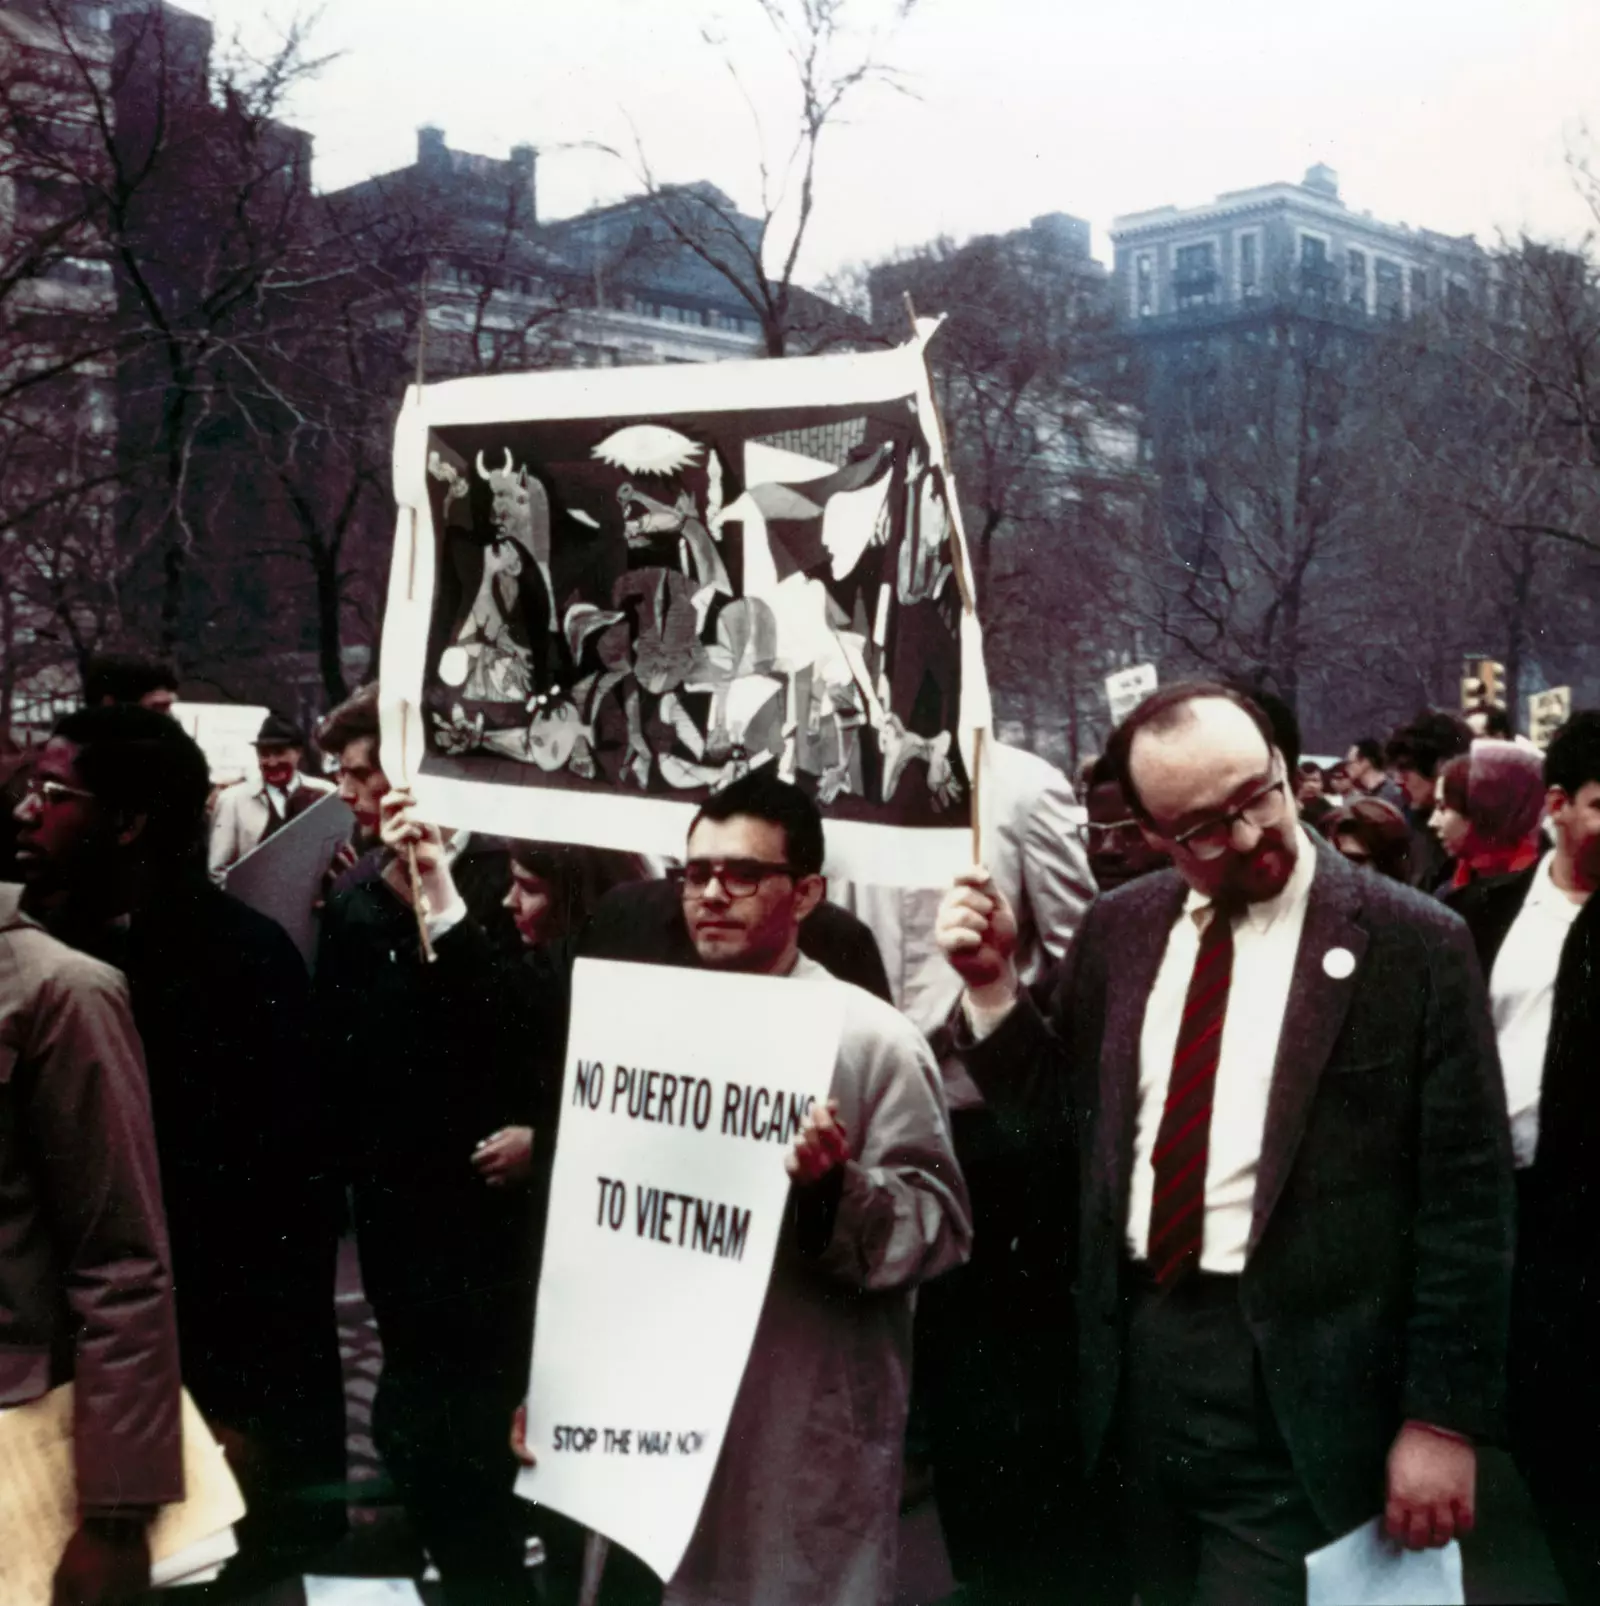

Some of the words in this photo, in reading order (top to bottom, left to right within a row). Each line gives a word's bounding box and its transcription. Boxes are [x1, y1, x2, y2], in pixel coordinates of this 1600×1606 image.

[572, 1059, 603, 1110] NO
[610, 1064, 712, 1131] PUERTO
[597, 1176, 626, 1231] TO
[636, 1185, 752, 1262] VIETNAM
[552, 1425, 597, 1453] STOP
[603, 1428, 632, 1455] THE
